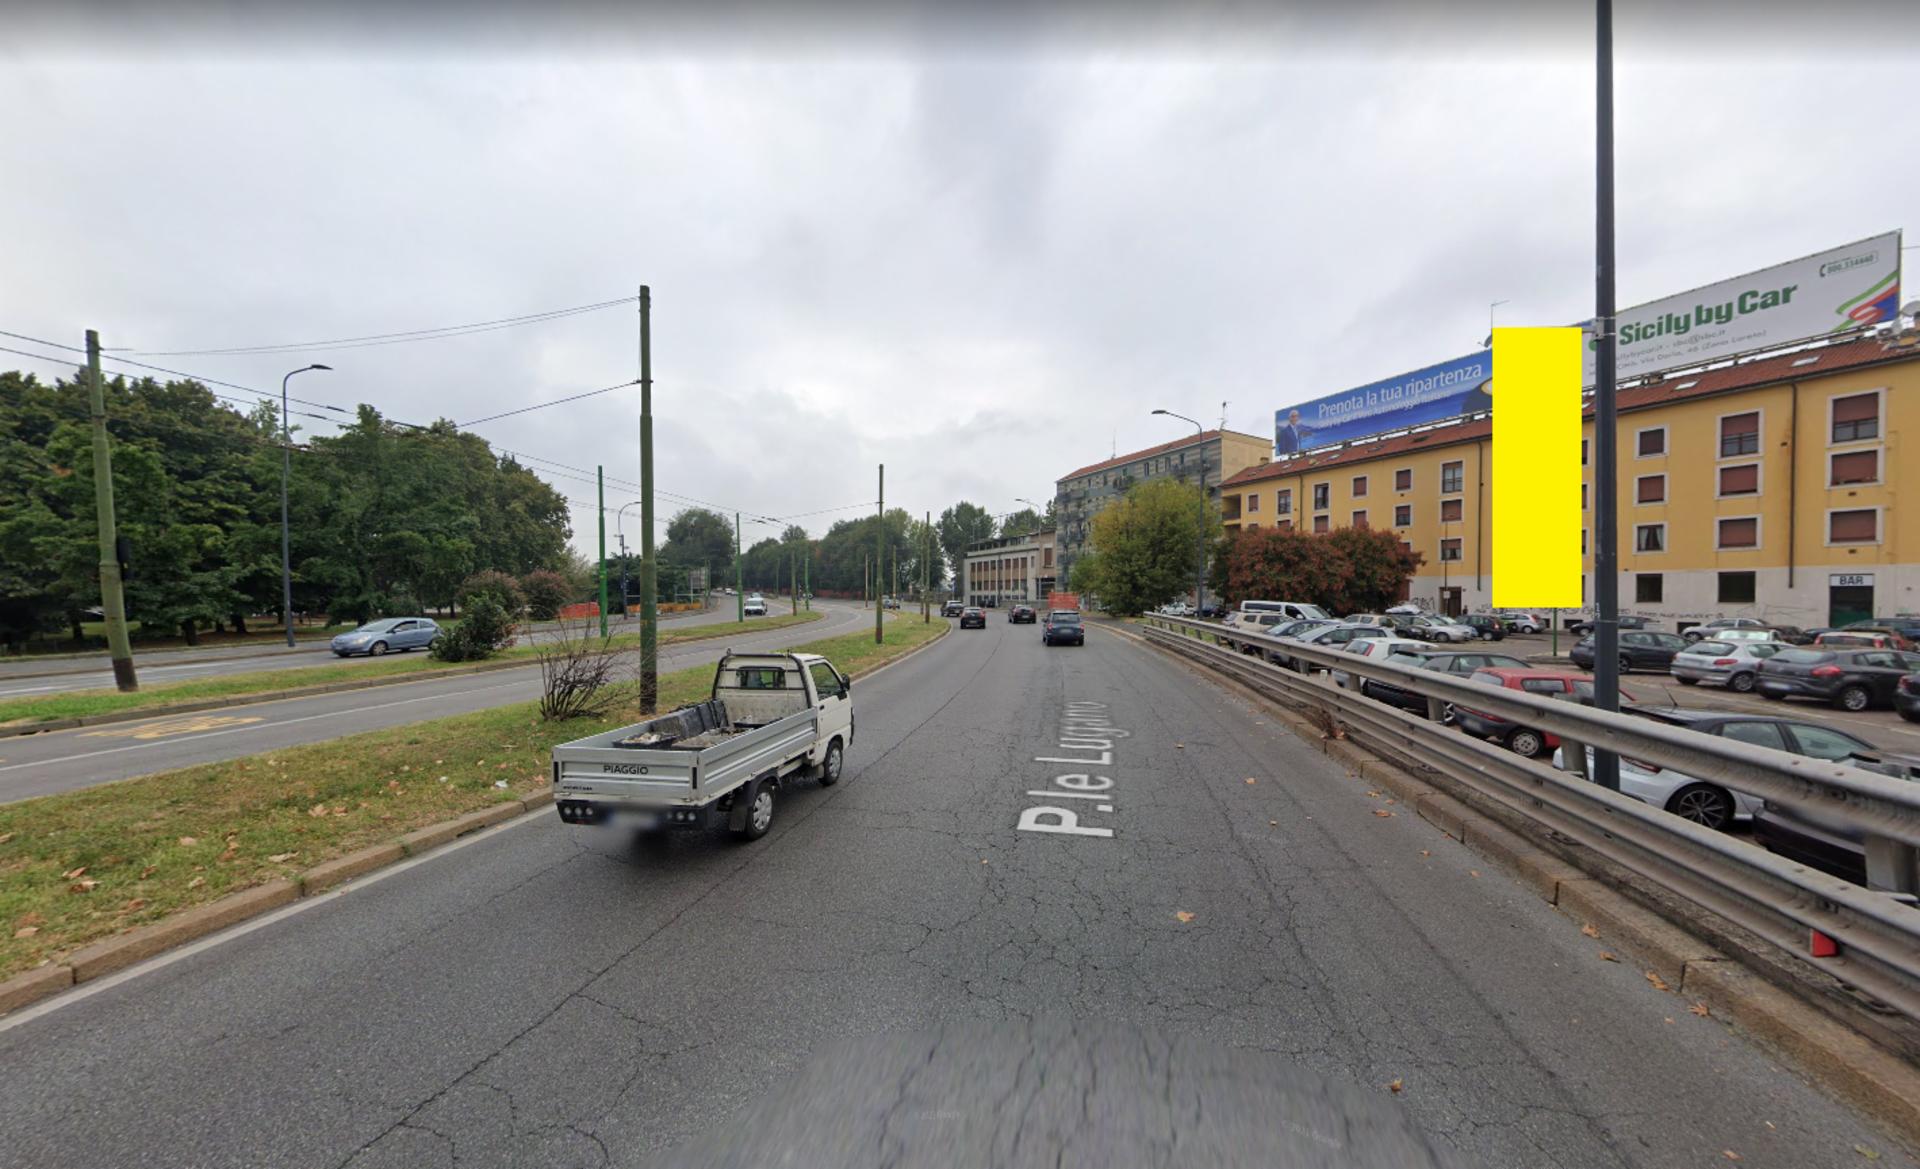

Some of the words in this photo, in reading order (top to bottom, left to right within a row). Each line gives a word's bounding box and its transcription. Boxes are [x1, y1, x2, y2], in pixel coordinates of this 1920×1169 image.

[1619, 313, 1691, 346] Sicily
[1695, 303, 1733, 325] by
[1738, 284, 1798, 315] Car
[1318, 395, 1364, 418] Prenota
[1366, 390, 1377, 407] la
[1380, 385, 1402, 403] tua
[1405, 363, 1483, 399] ripartenza
[1839, 575, 1864, 585] BAR
[603, 765, 649, 775] PIAGGIO
